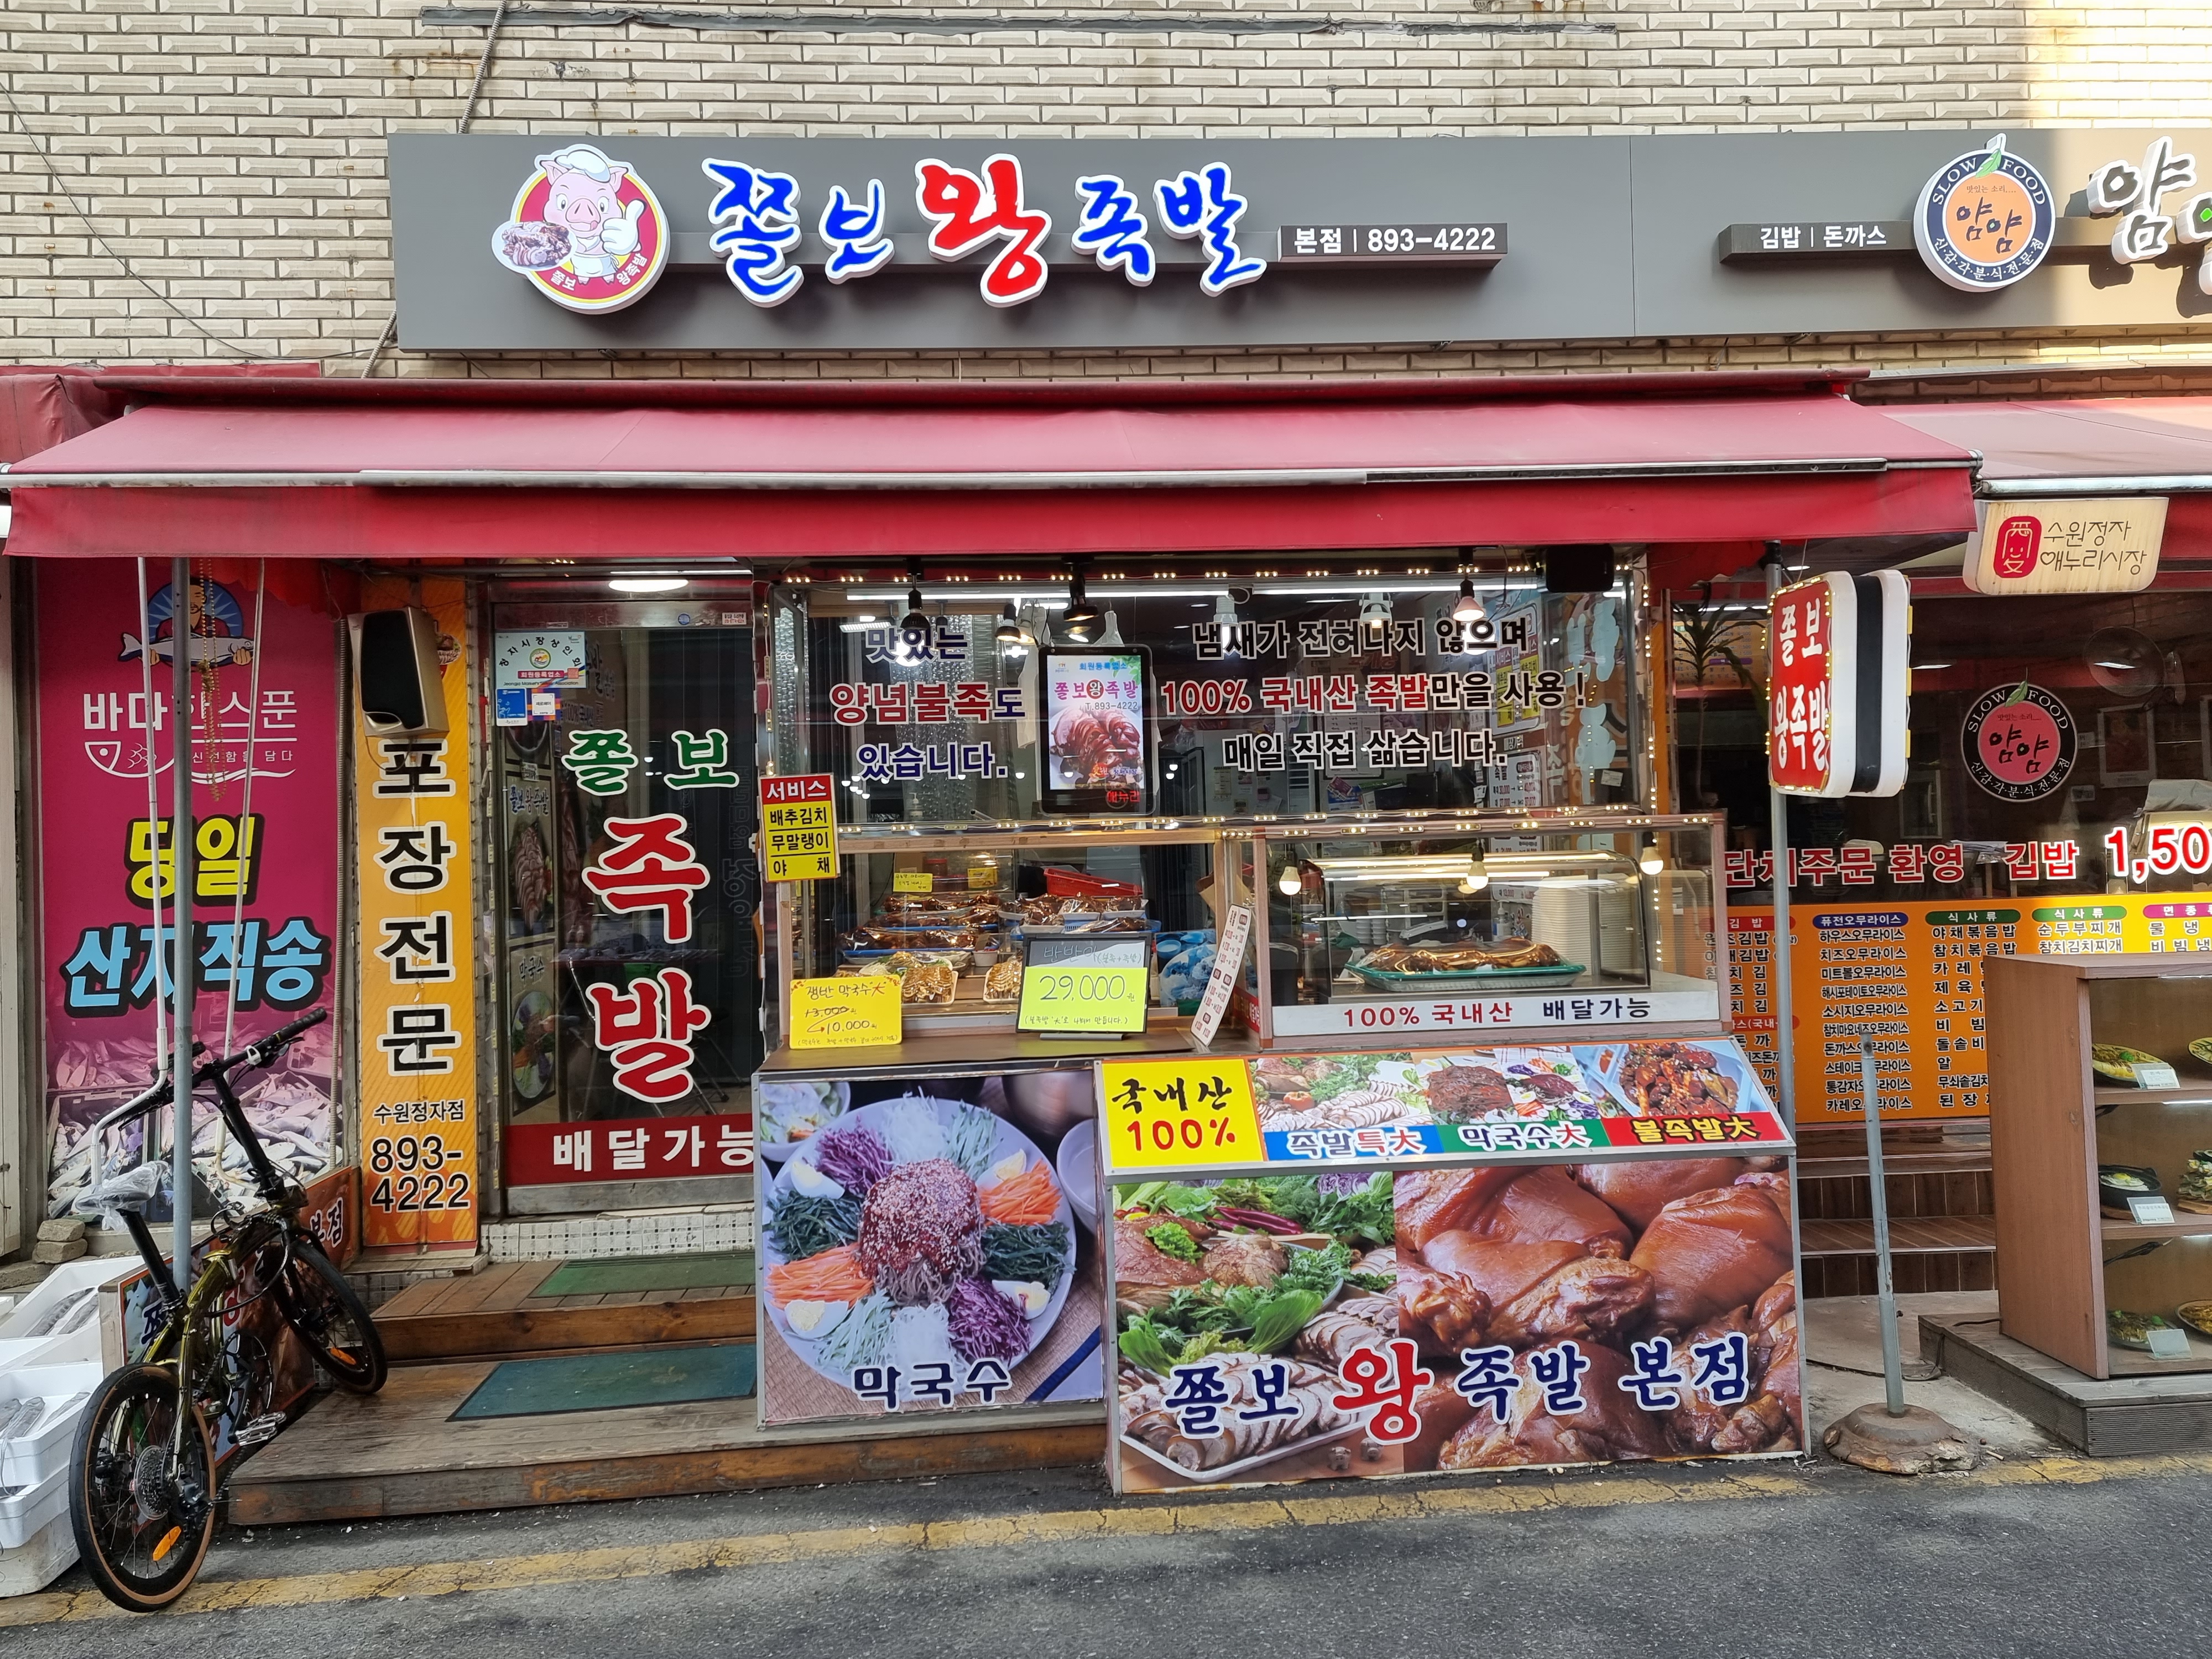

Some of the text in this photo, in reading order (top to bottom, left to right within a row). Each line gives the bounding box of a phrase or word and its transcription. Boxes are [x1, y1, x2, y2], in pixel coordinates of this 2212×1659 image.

[1933, 157, 2046, 205] SLOW FOOD
[1966, 185, 1989, 194] 맛있는
[1294, 227, 1496, 254] 본점 893-4222
[1760, 223, 1887, 249] 김밥 돈까스
[550, 253, 648, 291] 쫄보 왕족발
[2043, 520, 2132, 547] 수원정자
[866, 625, 970, 663] 맛있는
[1192, 620, 1290, 661] 냄새가
[1436, 615, 1528, 656] 않으며
[1779, 597, 1823, 667] 쫄보
[1079, 662, 1127, 670] 회원등록업소
[830, 681, 1025, 726] 양념불족도
[1161, 677, 1253, 715] 100%
[1260, 674, 1359, 713] 국내산
[1365, 670, 1495, 711] 족발만을
[1774, 680, 1829, 771] 왕족발
[1968, 690, 2068, 733] SLOW FOOD
[265, 750, 293, 763] 담다
[856, 741, 1008, 781] 있습니다.
[1222, 728, 1508, 772] 매일 직접 삶습니다.
[766, 780, 828, 801] 서비스
[770, 807, 828, 826] 배추김치
[771, 831, 829, 852] 무말랭이
[128, 815, 257, 901] 당일
[1888, 842, 1964, 884] 환영
[2002, 839, 2080, 881] 김밥
[1820, 914, 1902, 926] 퓨전오무라이스
[2037, 920, 2122, 937] 순두부찌개
[1819, 928, 1906, 943] 하우스오무라이스
[2038, 938, 2123, 954] 참치김치찌개
[1819, 946, 1907, 962] 치즈오무라이스
[518, 957, 545, 983] 막국수
[1820, 964, 1907, 980] 미트볼오무라이스
[1343, 998, 1652, 1027] 100% 국내산 배달가능
[1822, 1001, 1909, 1019] 소시지오무라이스
[1110, 1076, 1234, 1113] 국내산
[373, 1099, 465, 1123] 수원정자점
[1126, 1116, 1237, 1151] 100%
[369, 1174, 471, 1213] 4222
[852, 1358, 1012, 1412] 막국수
[1162, 1331, 1751, 1445] 쫄보 왕 족발 본점
